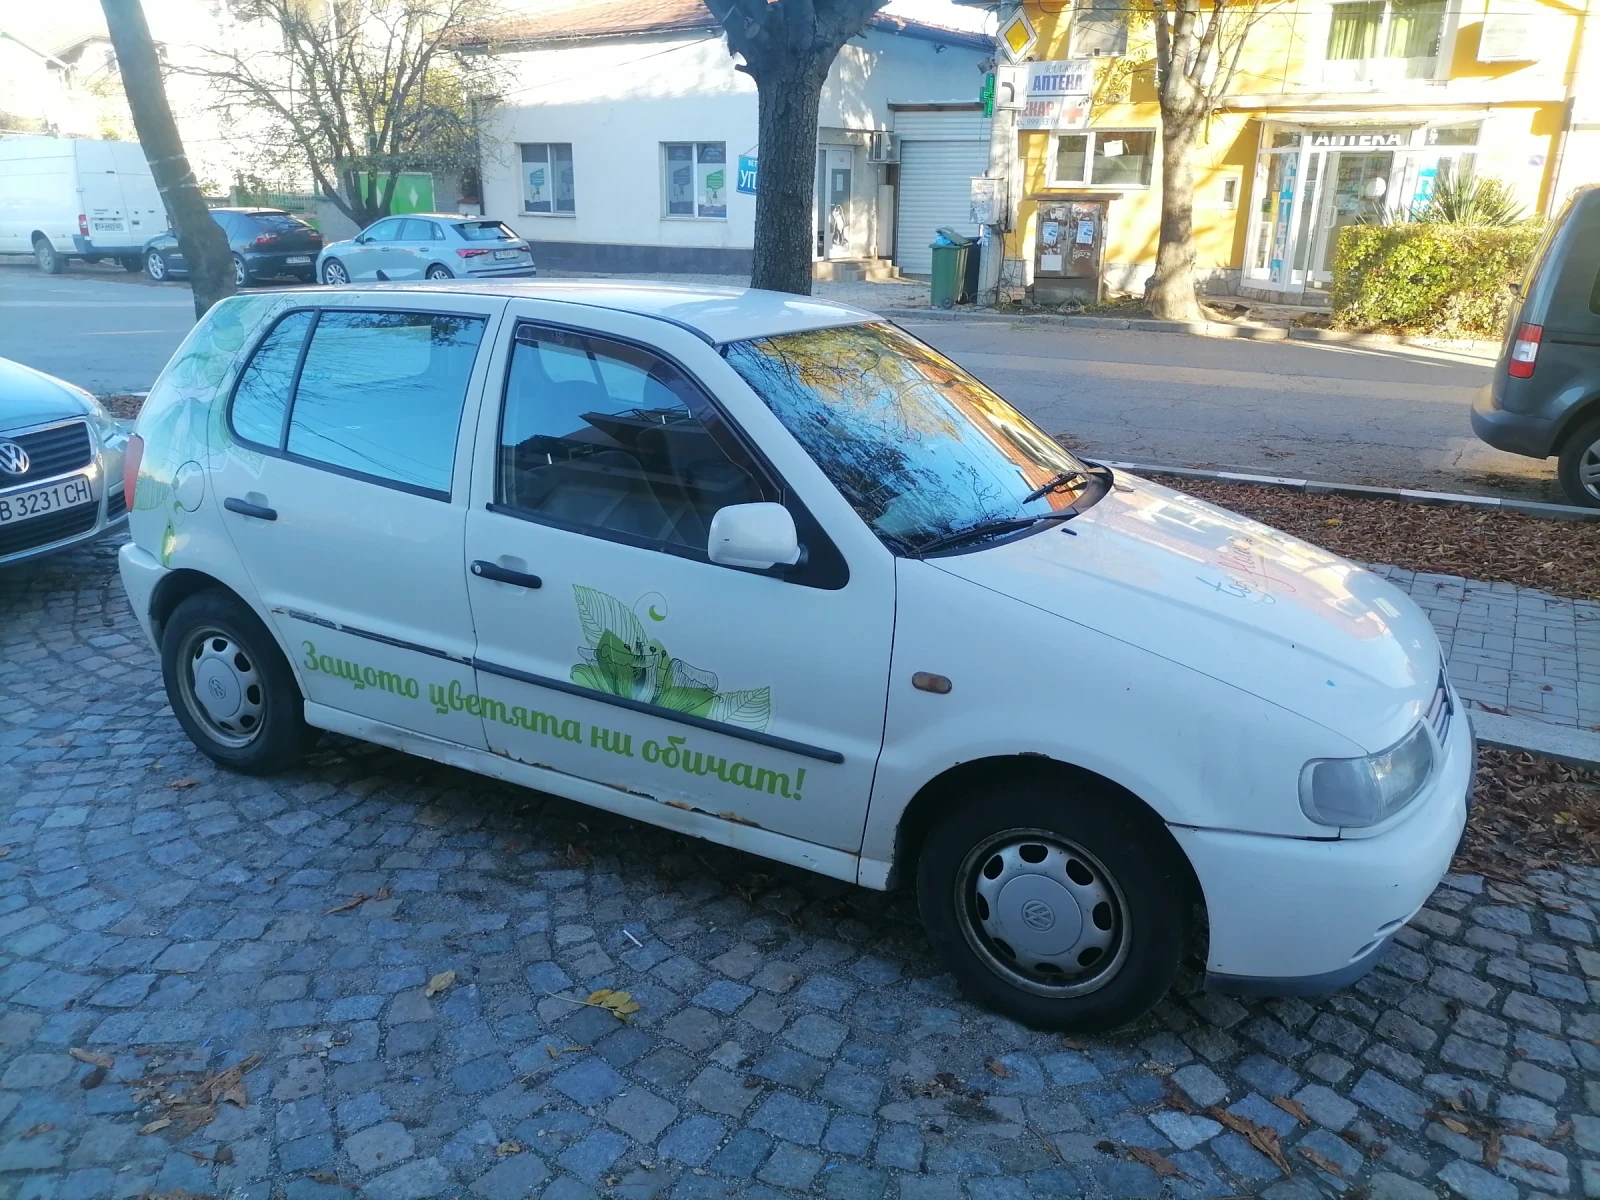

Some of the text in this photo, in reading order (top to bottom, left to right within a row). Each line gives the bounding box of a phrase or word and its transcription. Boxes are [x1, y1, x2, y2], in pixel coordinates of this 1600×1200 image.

[1032, 74, 1083, 91] АПТЕКА
[1314, 130, 1402, 146] АПТЕКА
[1269, 152, 1297, 283] АПТЕКА
[15, 488, 61, 517] 3231
[64, 480, 89, 504] CH
[301, 640, 807, 801] Защото цветята ни обичат!
